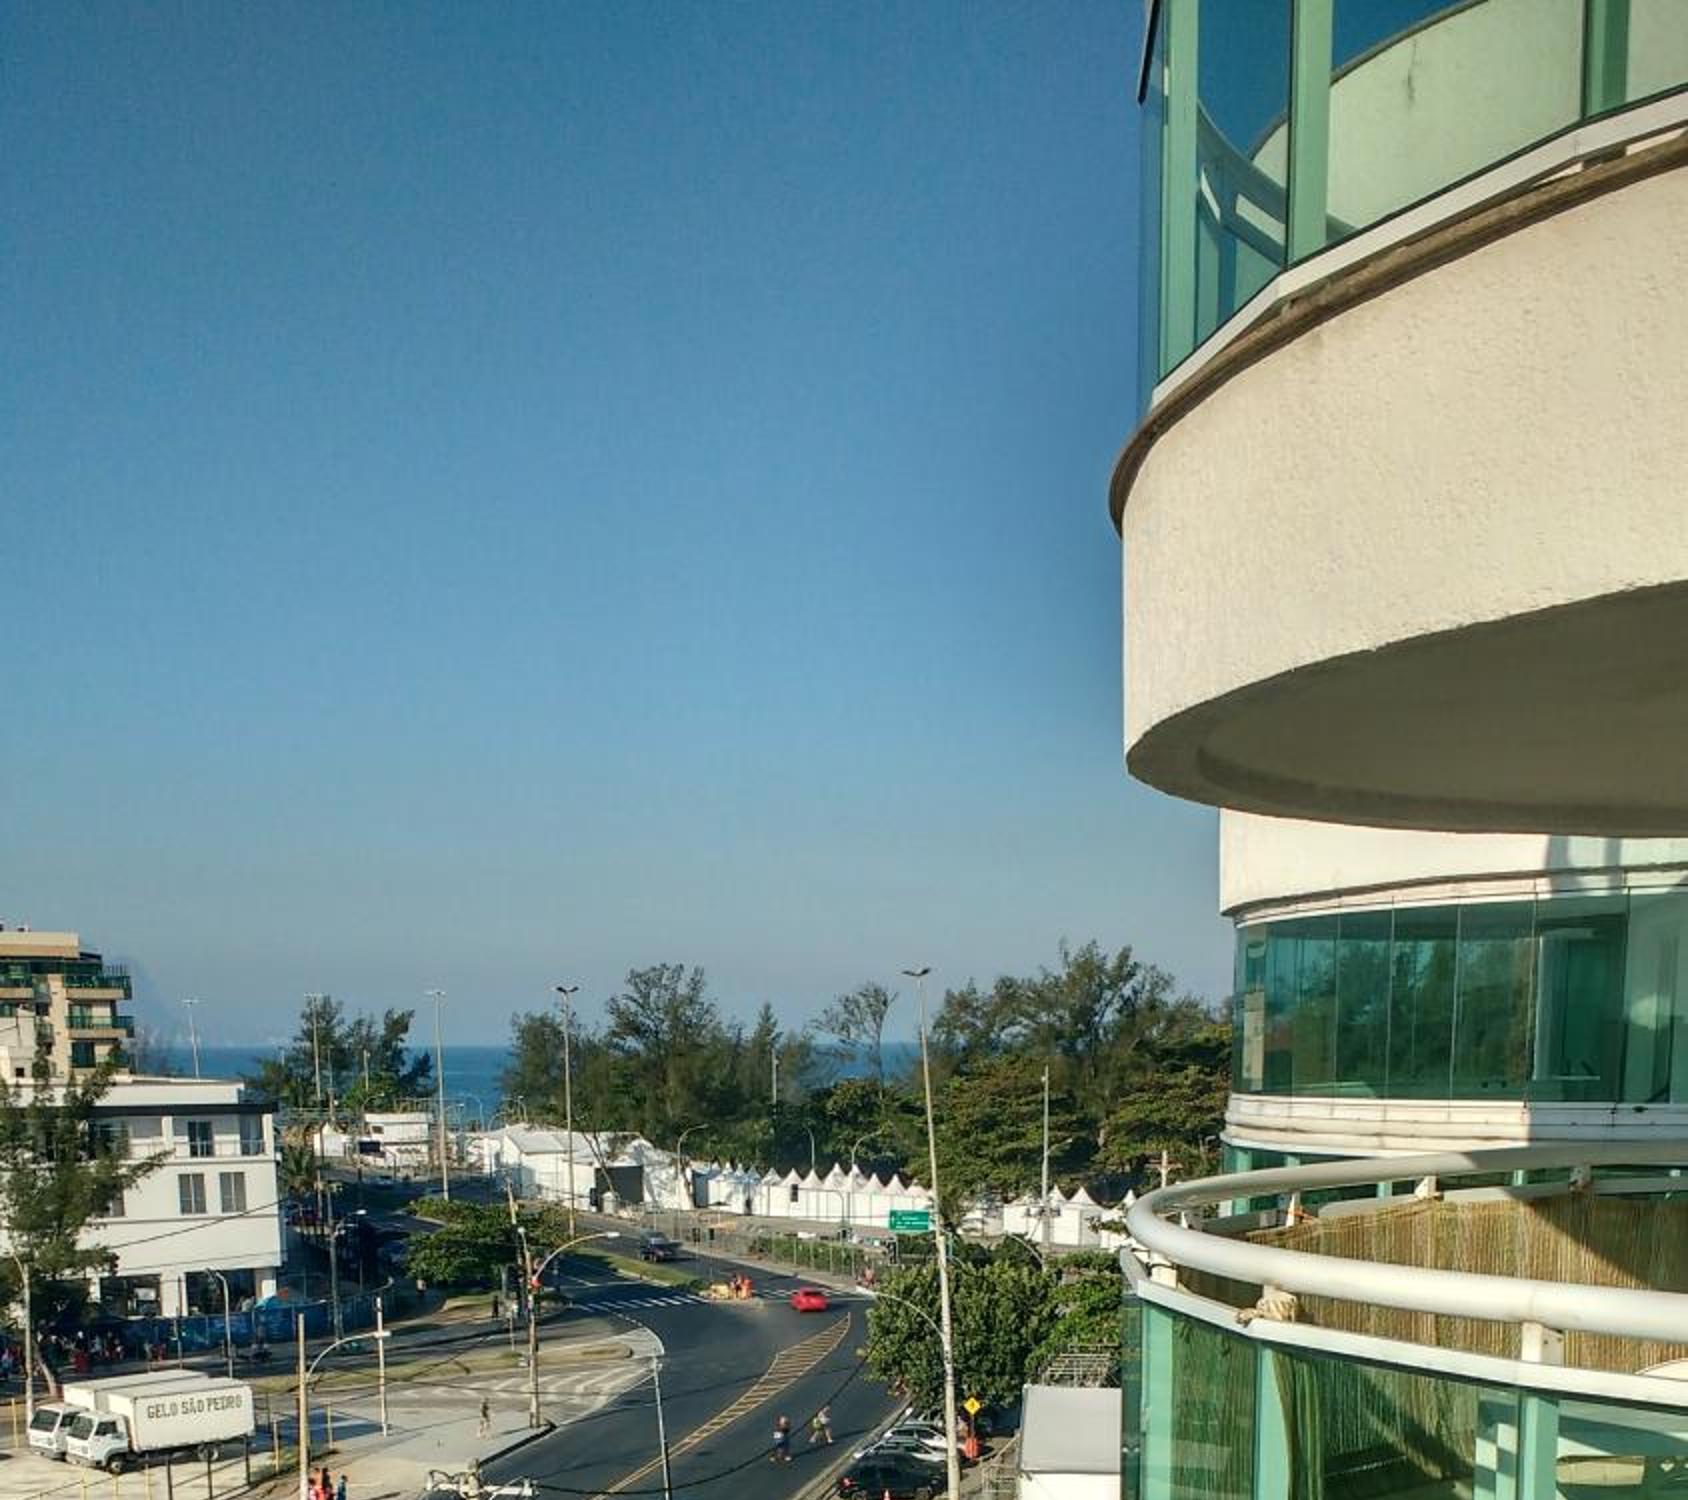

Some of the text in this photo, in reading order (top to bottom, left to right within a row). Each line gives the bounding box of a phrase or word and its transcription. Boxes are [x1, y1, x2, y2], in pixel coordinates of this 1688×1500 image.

[147, 1394, 243, 1419] GELO SÃO PEDRO
